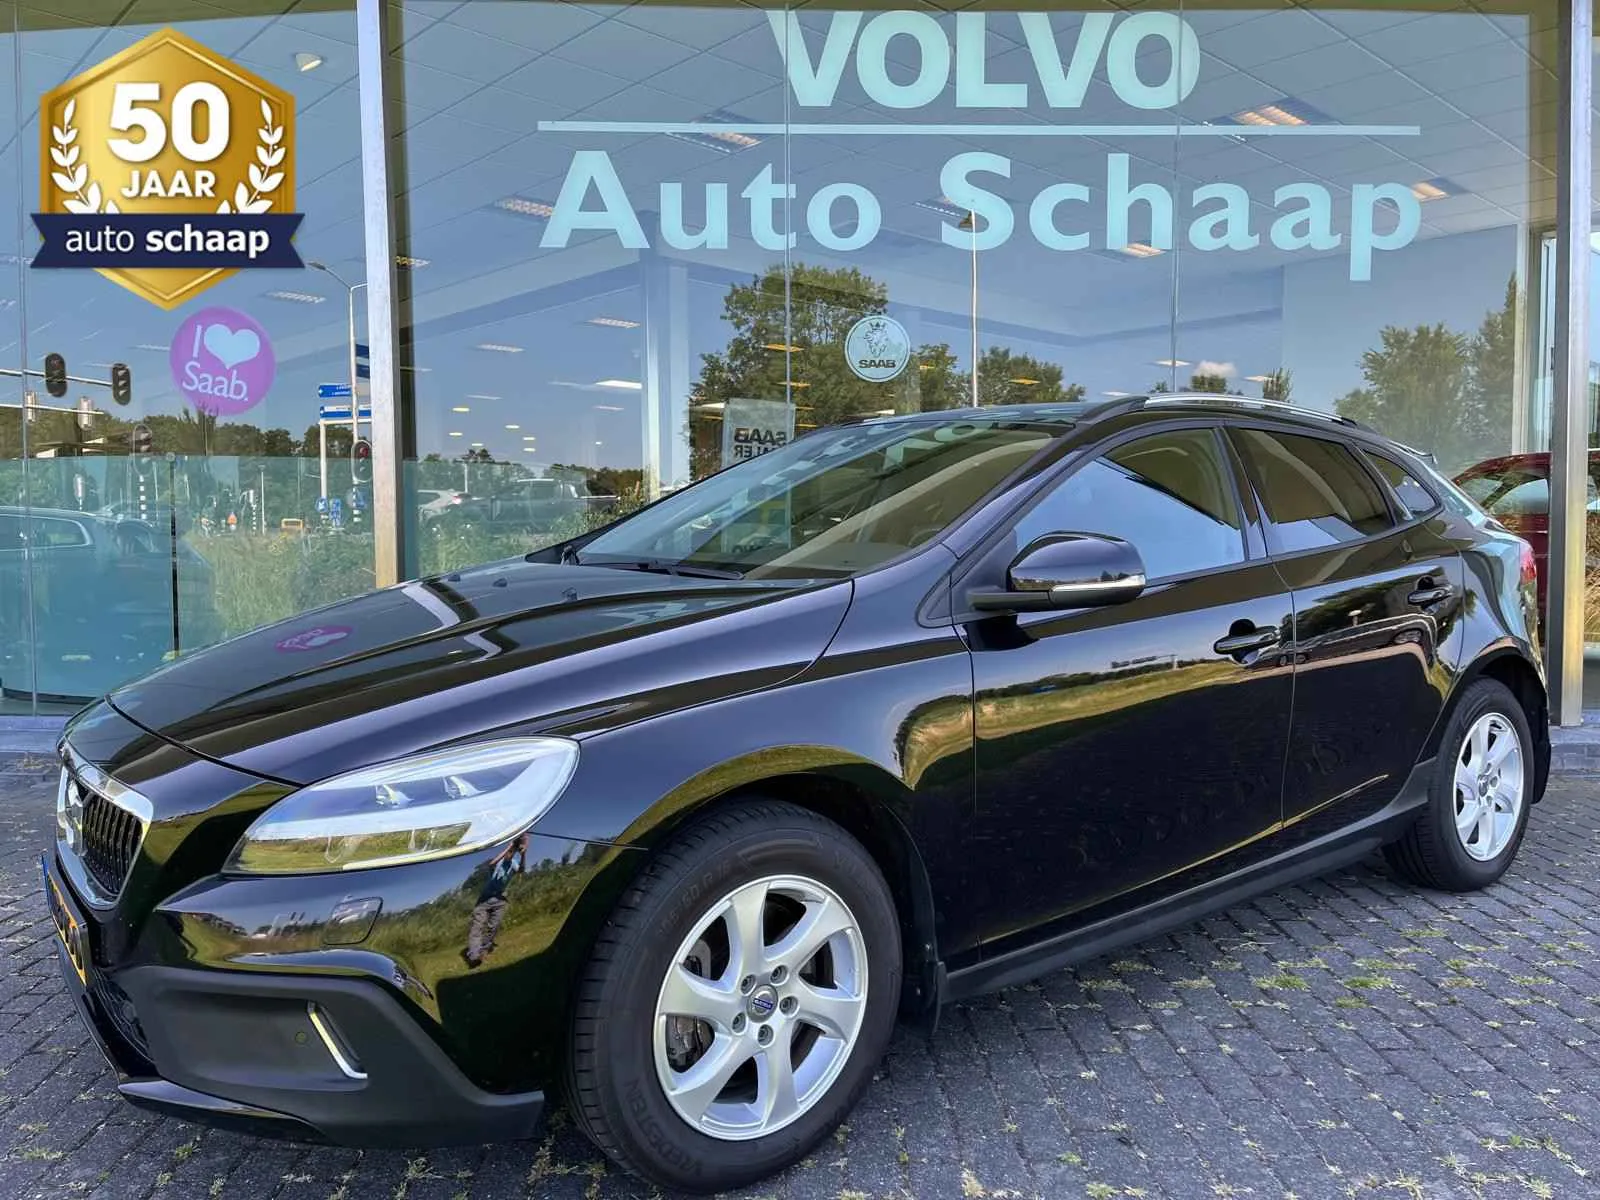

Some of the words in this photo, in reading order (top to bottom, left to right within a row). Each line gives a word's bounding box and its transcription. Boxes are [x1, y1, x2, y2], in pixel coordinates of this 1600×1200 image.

[767, 10, 1200, 109] VOLVO
[539, 150, 882, 252] Auto
[939, 152, 1422, 282] Schaap
[858, 359, 897, 369] SAAB
